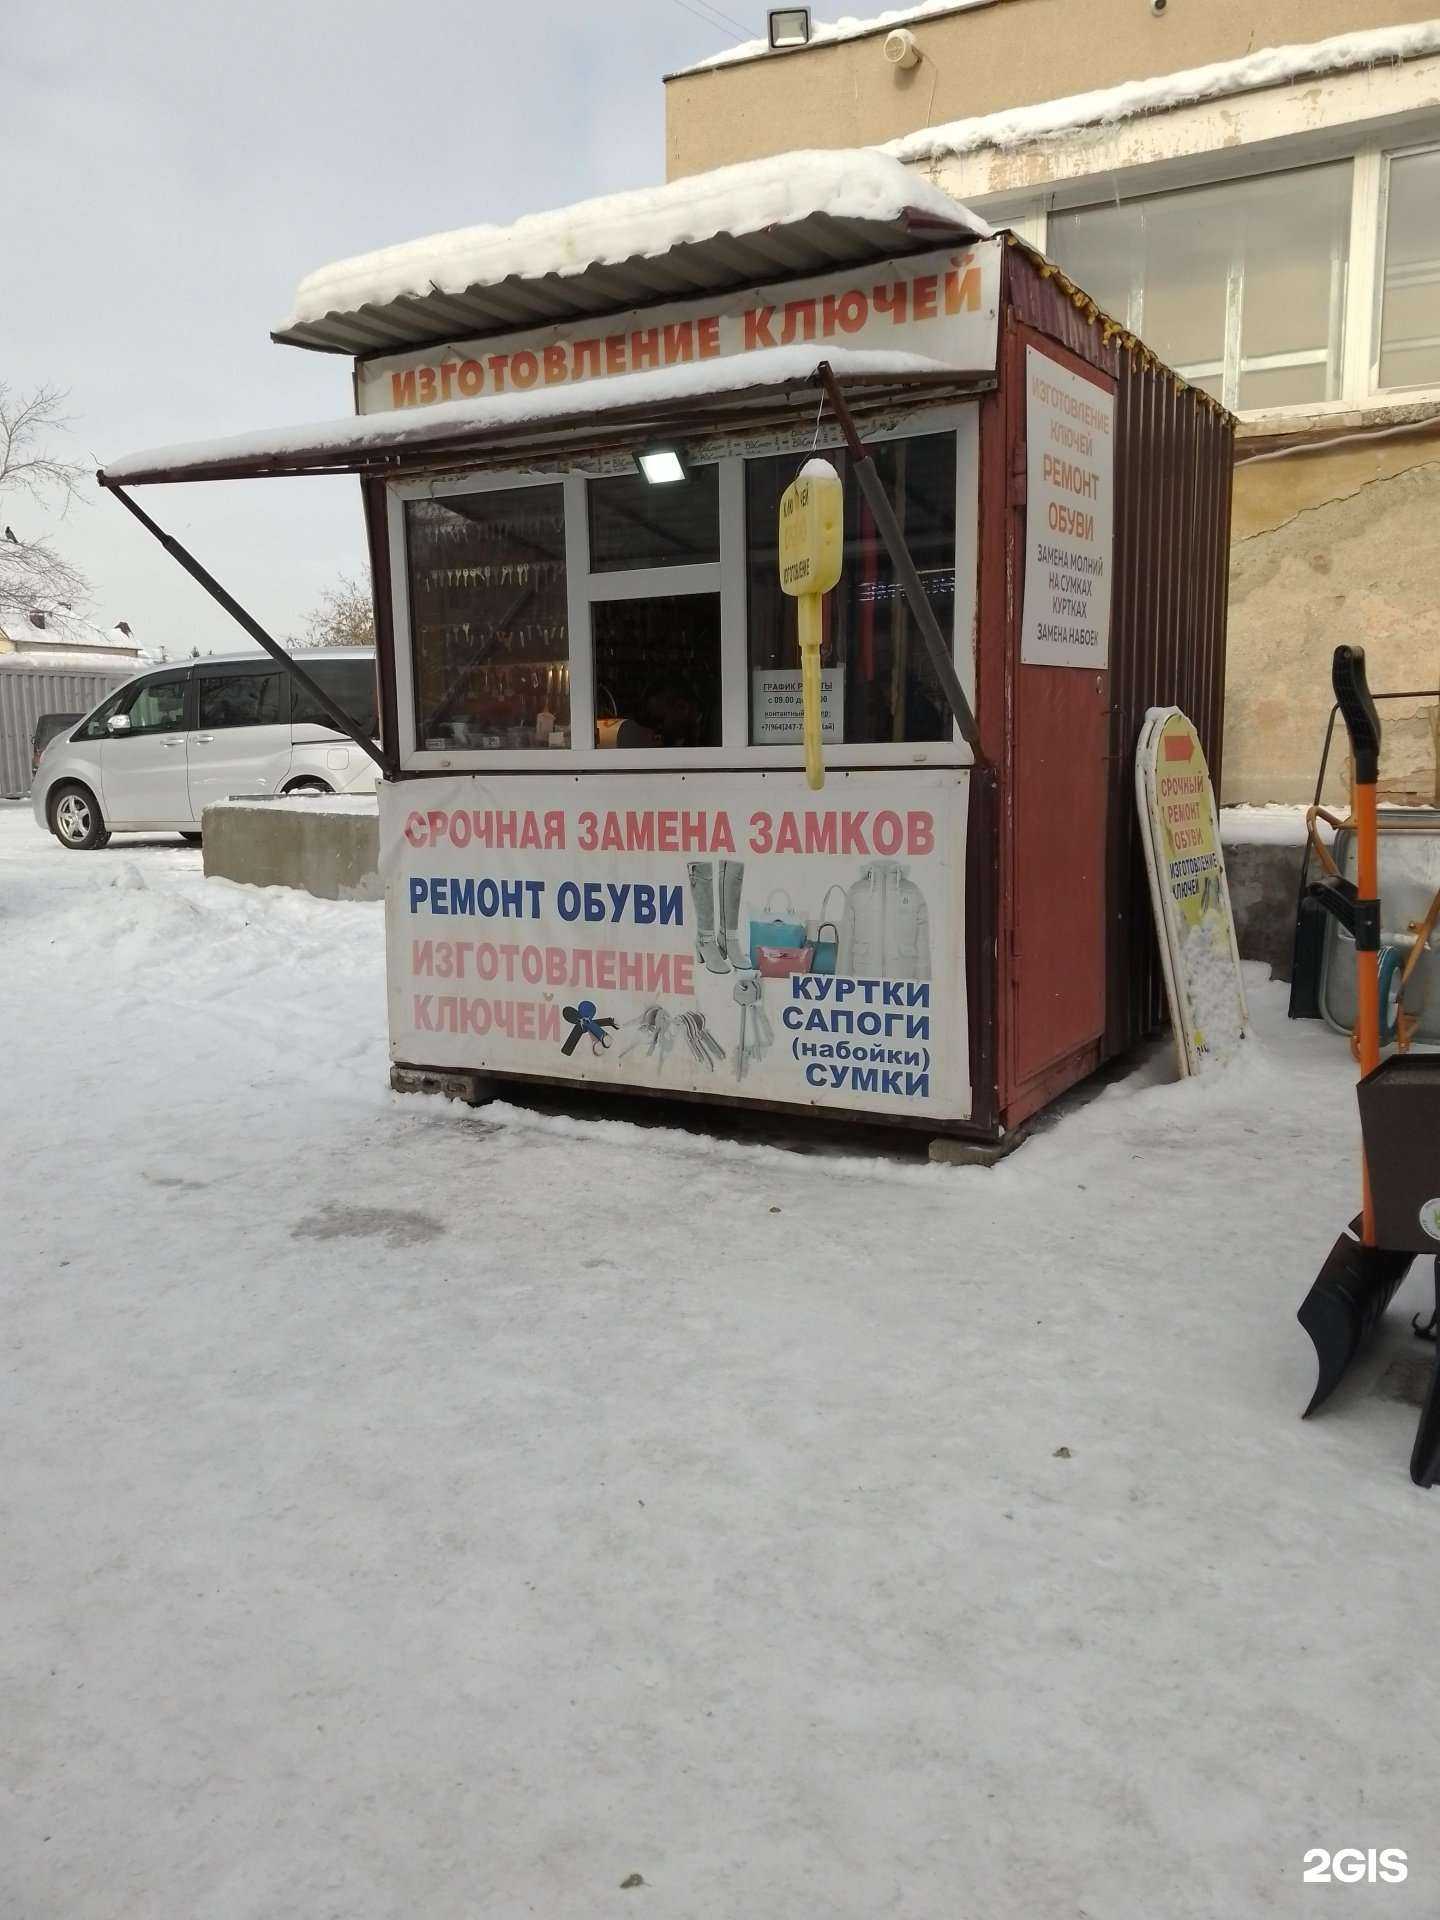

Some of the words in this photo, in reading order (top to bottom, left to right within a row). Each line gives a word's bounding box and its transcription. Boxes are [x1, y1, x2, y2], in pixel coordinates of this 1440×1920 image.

[392, 316, 722, 408] ИЗГОТОВЛЕНИЕ
[743, 253, 983, 351] КЛЮЧЕЙ
[1032, 375, 1110, 434] ИЗГОТОВЛЕНИЕ
[1050, 418, 1094, 457] КЛЮЧЕЙ
[1043, 453, 1100, 500] РЕМОНТ
[1048, 501, 1095, 541] ОБУВИ
[1037, 543, 1069, 569] ЗАМЕНА
[1070, 553, 1103, 576] МОЛНИЙ
[1048, 571, 1060, 591] НА
[1060, 574, 1093, 597] СУМКАХ
[1052, 597, 1087, 619] КУРТКАХ
[1037, 622, 1068, 643] ЗАМЕНА
[1068, 627, 1099, 646] НАБОЕК
[763, 682, 796, 691] ГРАФИК
[1161, 769, 1204, 797] СРОЧНЫЙ
[1167, 801, 1201, 824] РЕМОНТ
[404, 810, 567, 849] СРОЧНАЯ
[577, 811, 736, 853] ЗАМЕНА
[748, 810, 936, 856] ЗАМКОВ
[1174, 828, 1204, 850] ОБУВИ
[1169, 852, 1218, 879] ИЗГОТОВЛЕНИЕ
[409, 876, 546, 919] РЕМОНТ
[556, 882, 685, 926] ОБУВИ
[411, 939, 696, 996] ИЗГОТОВЛЕНИЕ
[791, 976, 931, 1008] КУРТКИ
[413, 992, 562, 1043] КЛЮЧЕЙ
[782, 1006, 931, 1041] САПОГИ
[791, 1038, 931, 1072] (набойки)
[806, 1063, 930, 1098] СУМКИ
